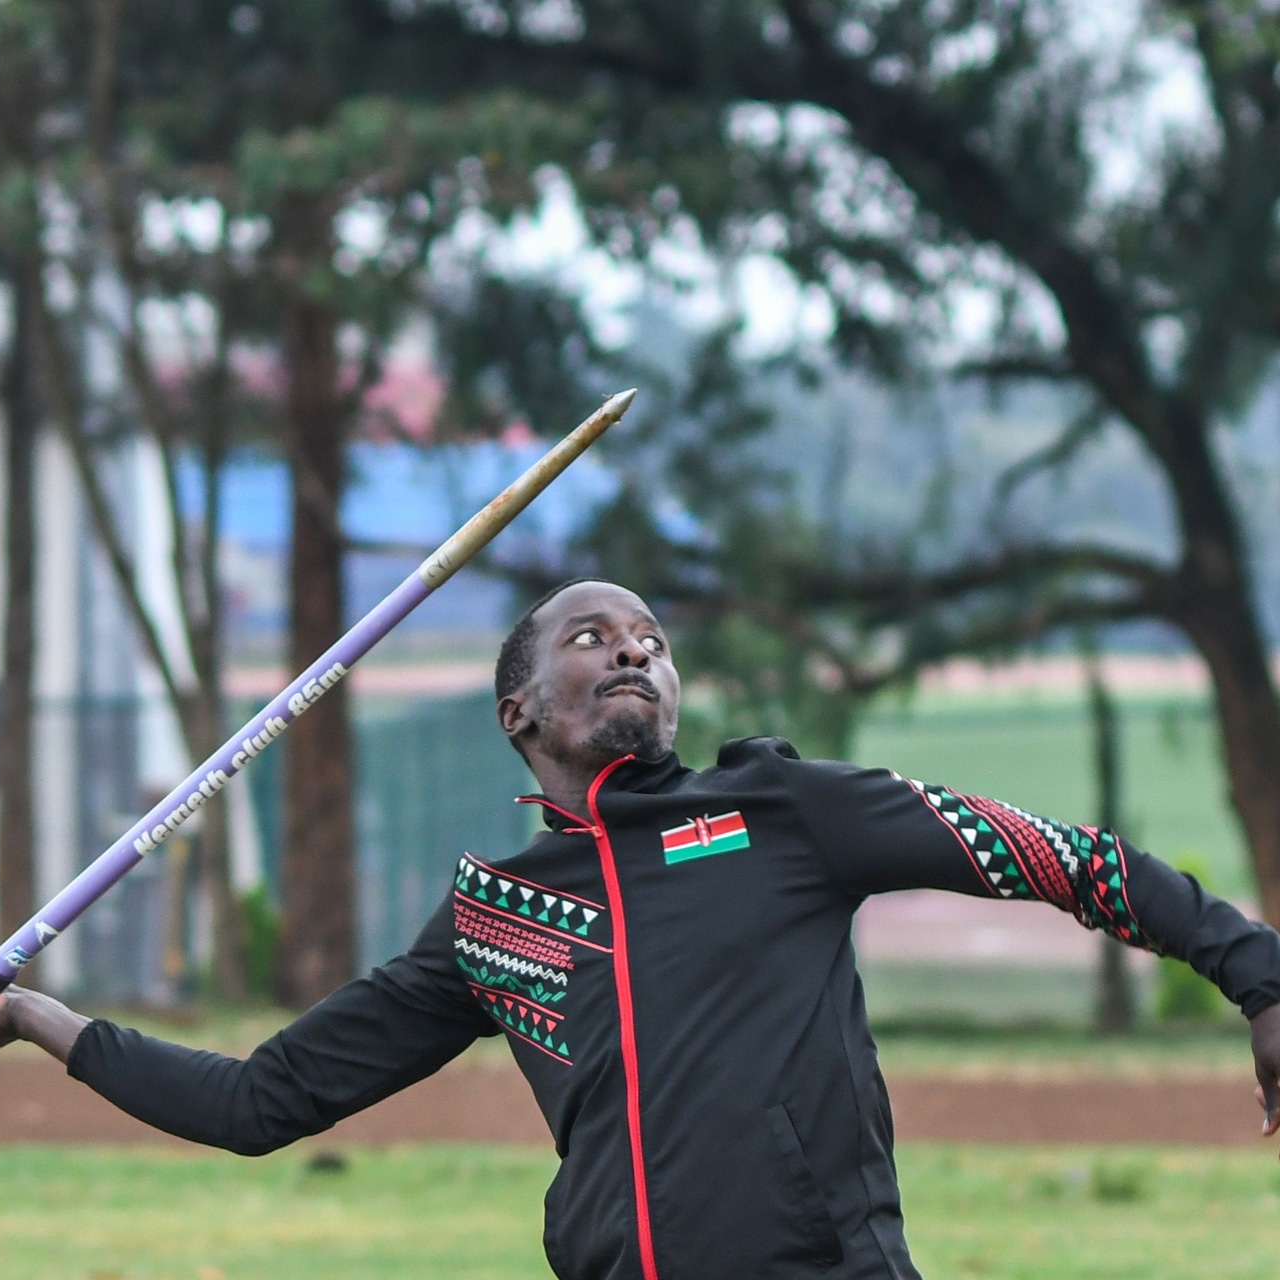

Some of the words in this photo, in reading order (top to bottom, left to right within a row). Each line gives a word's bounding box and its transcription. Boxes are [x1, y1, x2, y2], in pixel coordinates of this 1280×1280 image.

[133, 769, 231, 857] Nemeth
[231, 716, 289, 771] club
[287, 661, 349, 717] 85m
